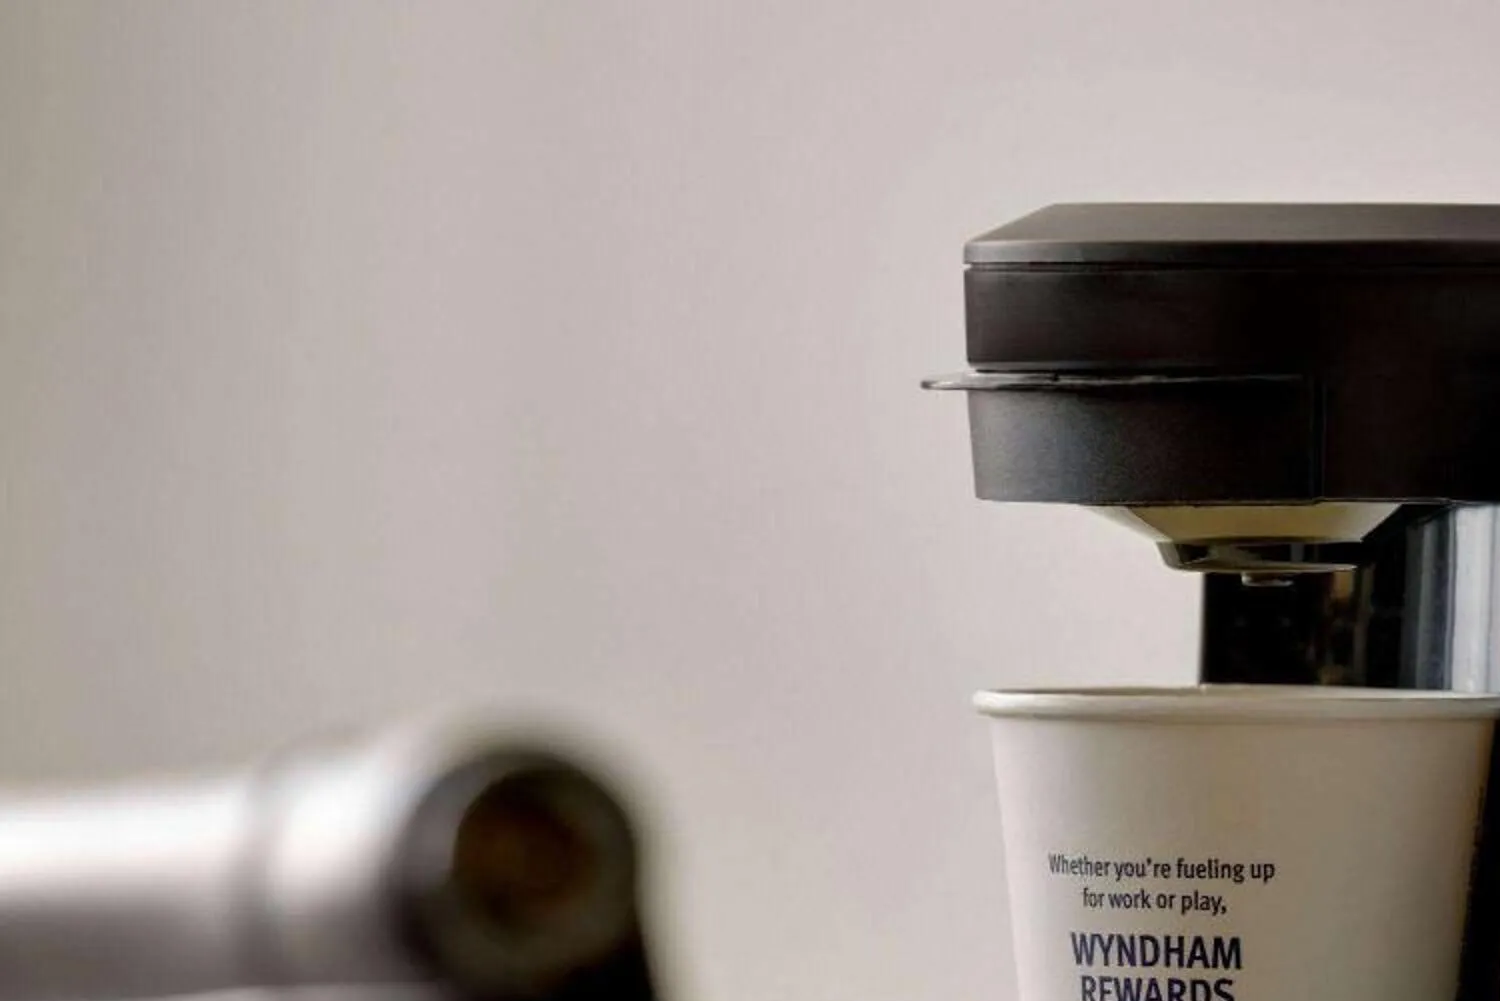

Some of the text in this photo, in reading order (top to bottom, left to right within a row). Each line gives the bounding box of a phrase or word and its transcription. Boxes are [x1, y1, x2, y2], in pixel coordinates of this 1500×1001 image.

[1048, 853, 1275, 883] Whether you're fueling up
[1083, 887, 1227, 916] for work or play,
[1070, 932, 1243, 971] WYNDHAM
